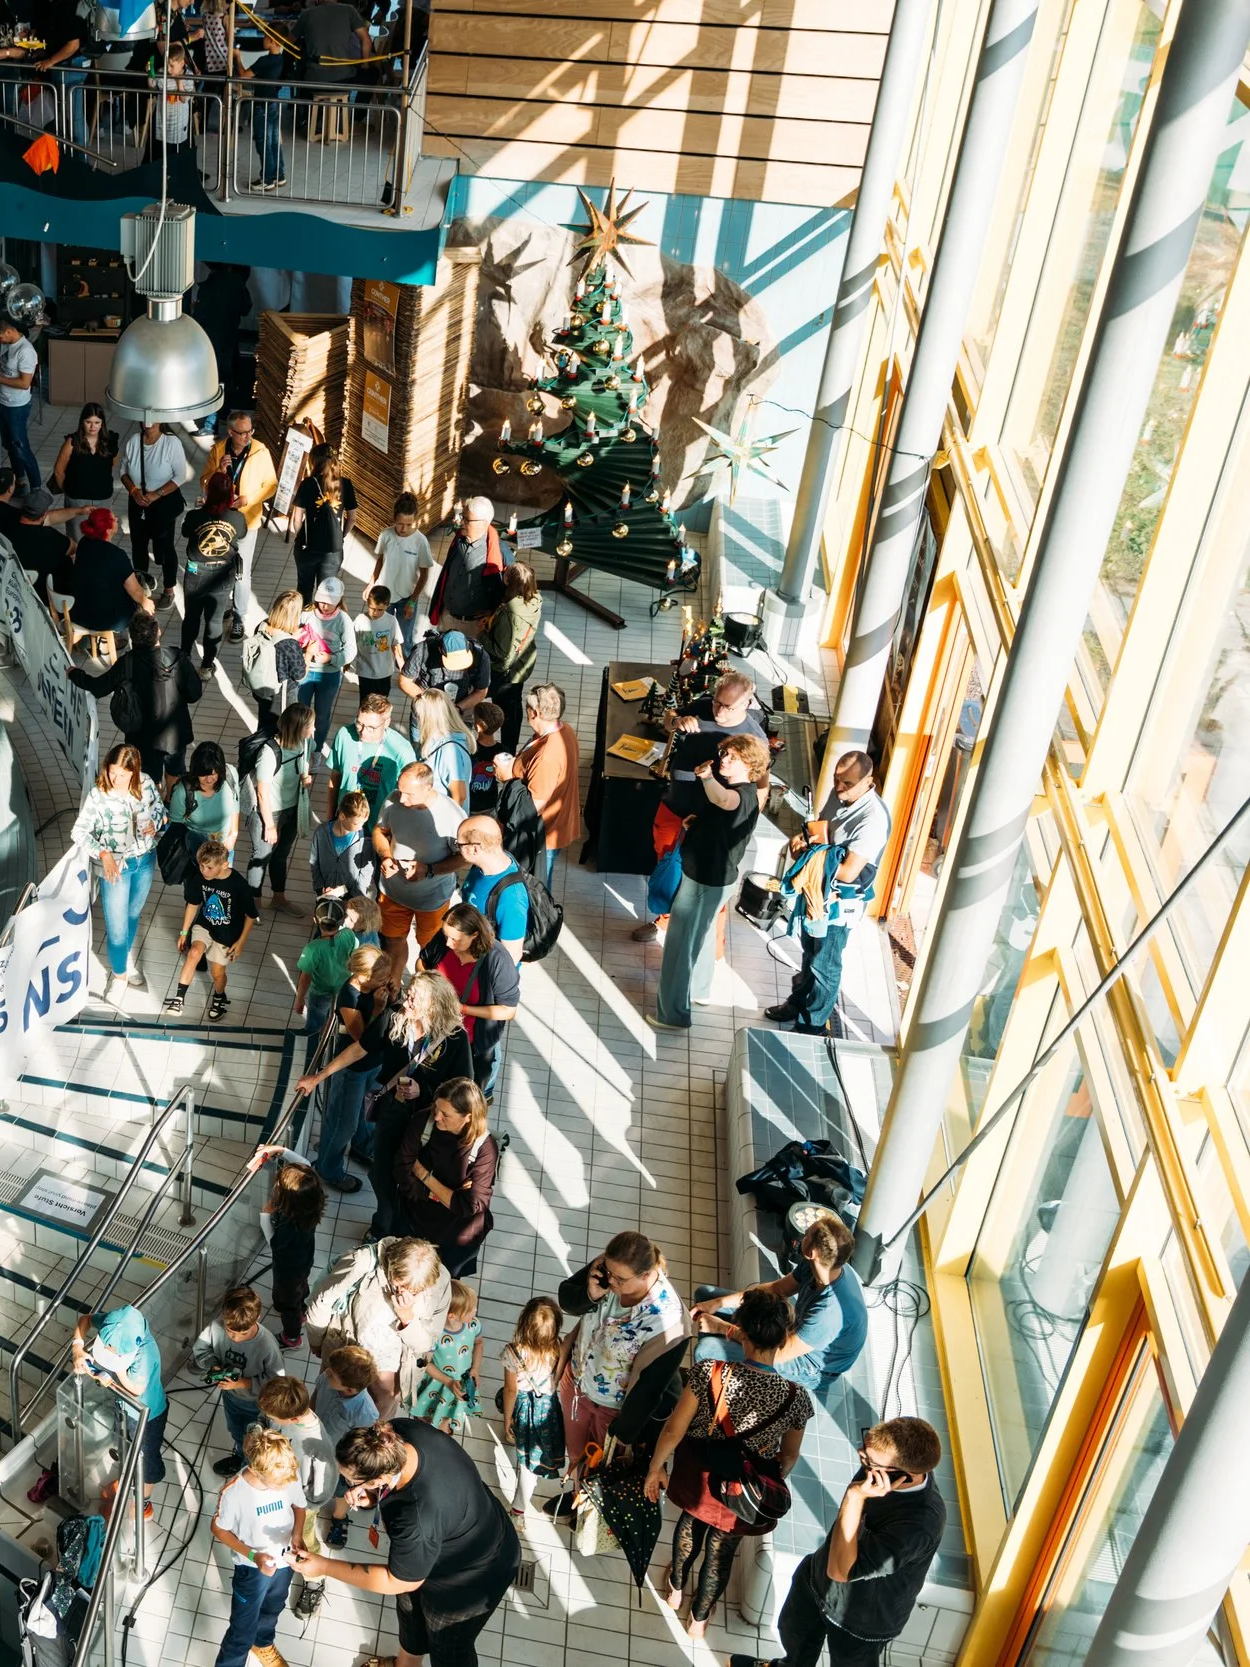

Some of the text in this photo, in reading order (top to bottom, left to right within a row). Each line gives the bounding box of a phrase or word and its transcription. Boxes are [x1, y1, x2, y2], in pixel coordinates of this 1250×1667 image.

[34, 1194, 86, 1217] Vorsicht Stufe
[77, 1200, 98, 1210] please
[256, 1500, 283, 1516] PUMA
